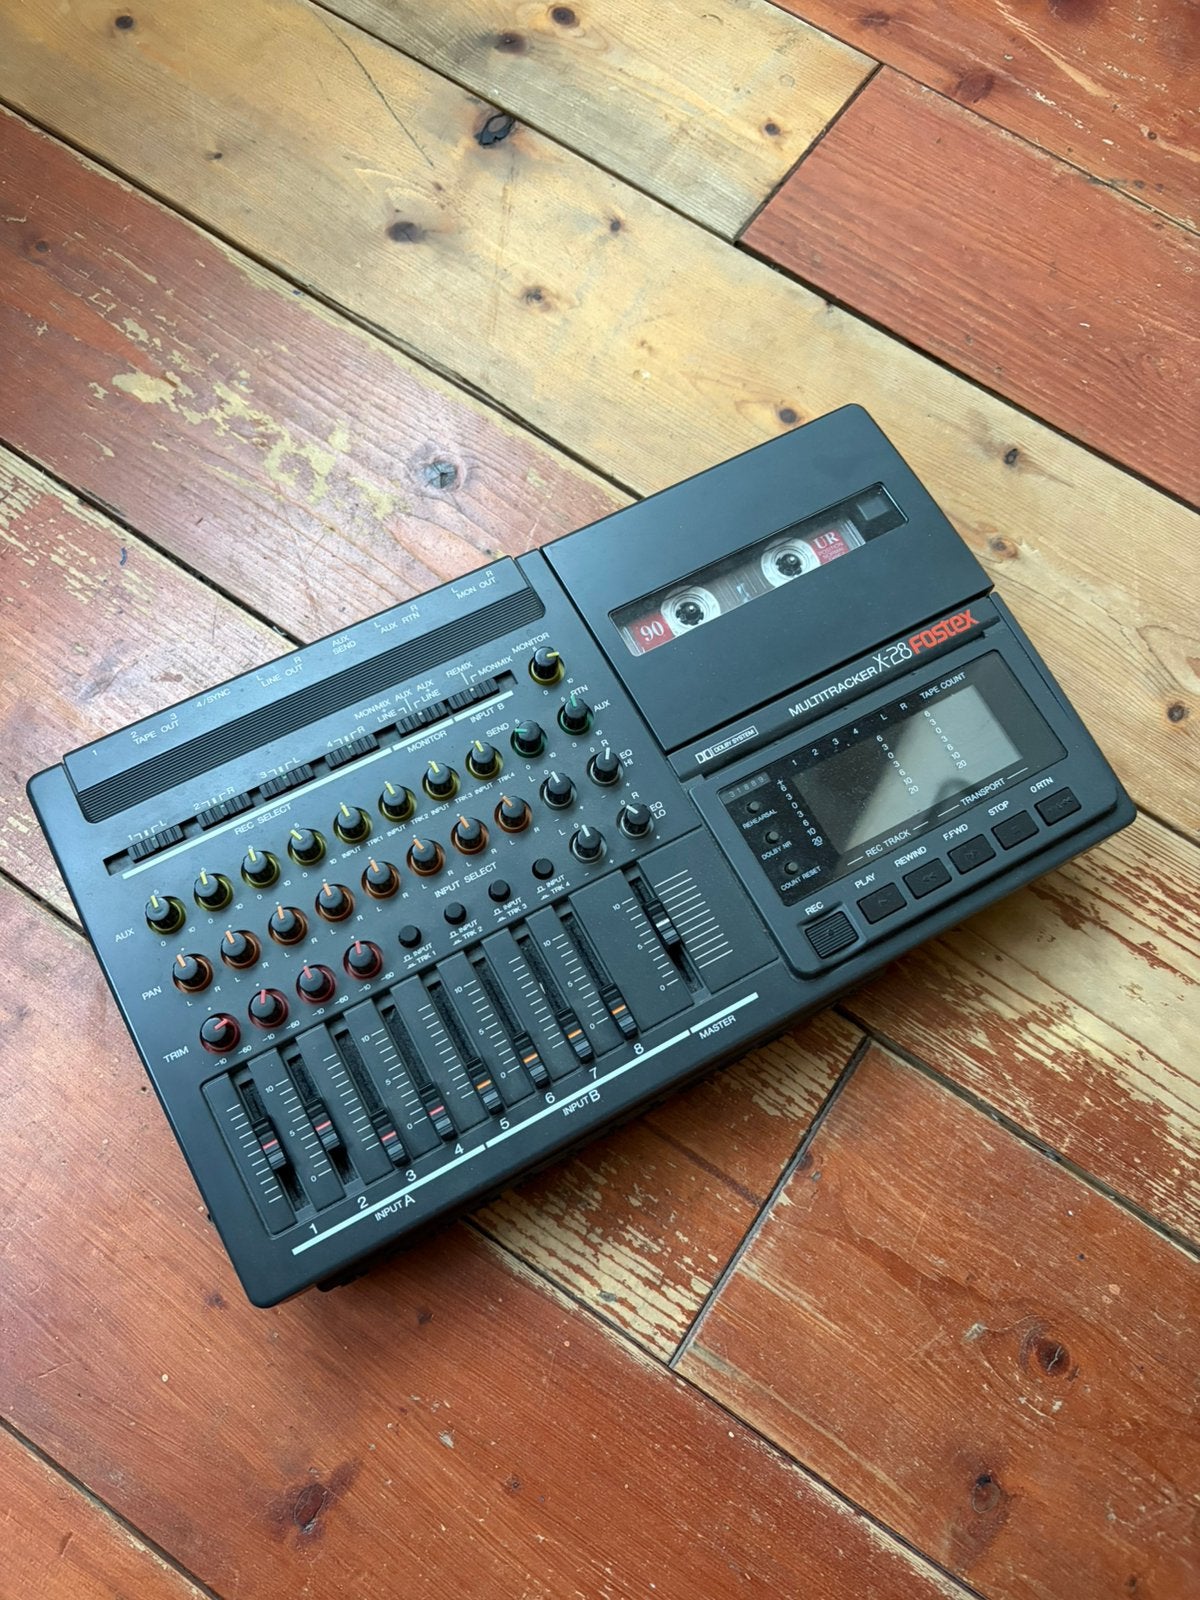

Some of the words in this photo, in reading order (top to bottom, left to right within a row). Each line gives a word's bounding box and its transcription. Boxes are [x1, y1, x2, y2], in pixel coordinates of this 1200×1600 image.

[813, 532, 839, 549] UR
[485, 570, 494, 578] R
[456, 586, 478, 600] MON
[478, 577, 497, 589] OUT
[410, 604, 419, 612] R
[380, 622, 399, 634] AUX
[401, 612, 421, 624] RTN
[640, 620, 665, 642] 90
[332, 634, 351, 648] AUX
[332, 640, 357, 656] SEND
[511, 632, 550, 654] MONITOR
[293, 655, 302, 664] R
[478, 656, 513, 677] MONMIX
[260, 674, 282, 688] LINE
[285, 664, 303, 677] OUT
[445, 661, 474, 678] REMIX
[788, 666, 879, 717] MULTITRACKER
[872, 641, 913, 673] X-28
[919, 687, 940, 700] TAPE
[939, 672, 966, 690] COUNT
[196, 688, 231, 708] 4/SYNC
[421, 689, 441, 703] LINE
[570, 685, 589, 697] RTN
[354, 698, 392, 720] MONMIX
[394, 688, 413, 702] AUX
[416, 679, 435, 692] AUX
[593, 699, 611, 712] AUX
[900, 702, 908, 710] R
[170, 712, 177, 721] 3
[377, 709, 398, 723] LINE
[470, 707, 495, 723] INPUT
[497, 703, 505, 711] B
[131, 731, 138, 739] 2
[133, 731, 157, 745] TAPE
[160, 720, 180, 733] OUT
[486, 722, 510, 737] SEND
[407, 730, 448, 753] MONITOR
[600, 739, 609, 747] R
[713, 741, 733, 753] DOLBY
[731, 729, 755, 744] SYSTEM
[941, 735, 948, 743] 3
[619, 749, 633, 760] EQ
[951, 752, 960, 760] 10
[624, 758, 634, 767] HI
[956, 760, 967, 769] 20
[904, 777, 912, 785] 10
[631, 791, 639, 799] R
[908, 785, 919, 794] 20
[960, 778, 1006, 806] TRANSPORT
[650, 801, 663, 812] EQ
[654, 809, 666, 819] LO
[988, 800, 1010, 816] STOP
[234, 821, 255, 835] REC
[257, 803, 292, 824] SELECT
[341, 846, 361, 858] INPUT
[386, 824, 407, 837] INPUT
[430, 803, 450, 816] INPUT
[471, 782, 494, 795] INPUT
[742, 809, 777, 830] REHEARSAL
[761, 847, 781, 860] DOLBY
[782, 841, 792, 850] NR
[865, 845, 883, 857] REC
[883, 830, 911, 848] TRACK
[894, 846, 927, 868] REWIND
[433, 880, 461, 899] INPUT
[463, 862, 498, 884] SELECT
[545, 874, 566, 889] INPUT
[781, 877, 801, 891] COUNT
[802, 866, 822, 879] RESET
[854, 873, 876, 889] PLAY
[551, 884, 565, 895] TRK
[502, 897, 523, 911] INPUT
[612, 903, 621, 911] 10
[805, 901, 824, 916] REC
[507, 907, 522, 918] TRK
[458, 919, 478, 934] INPUT
[115, 928, 135, 942] AUX
[462, 929, 478, 940] TRK
[412, 942, 433, 958] INPUT
[417, 954, 431, 965] TRK
[141, 986, 162, 1001] PAN
[454, 986, 463, 994] 10
[478, 1028, 485, 1036] 5
[699, 1014, 737, 1040] MASTER
[361, 1034, 370, 1043] 10
[163, 1046, 189, 1064] TRIM
[265, 1085, 274, 1093] 10
[499, 1117, 510, 1130] 5
[545, 1092, 556, 1104] 6
[589, 1067, 597, 1080] 7
[633, 1043, 644, 1055] 8
[562, 1096, 590, 1117] INPUT
[590, 1089, 601, 1103] B
[309, 1223, 318, 1234] 1
[357, 1196, 369, 1209] 2
[405, 1169, 417, 1182] 3
[454, 1143, 464, 1155] 4
[375, 1203, 403, 1221] INPUT
[405, 1195, 416, 1208] A
